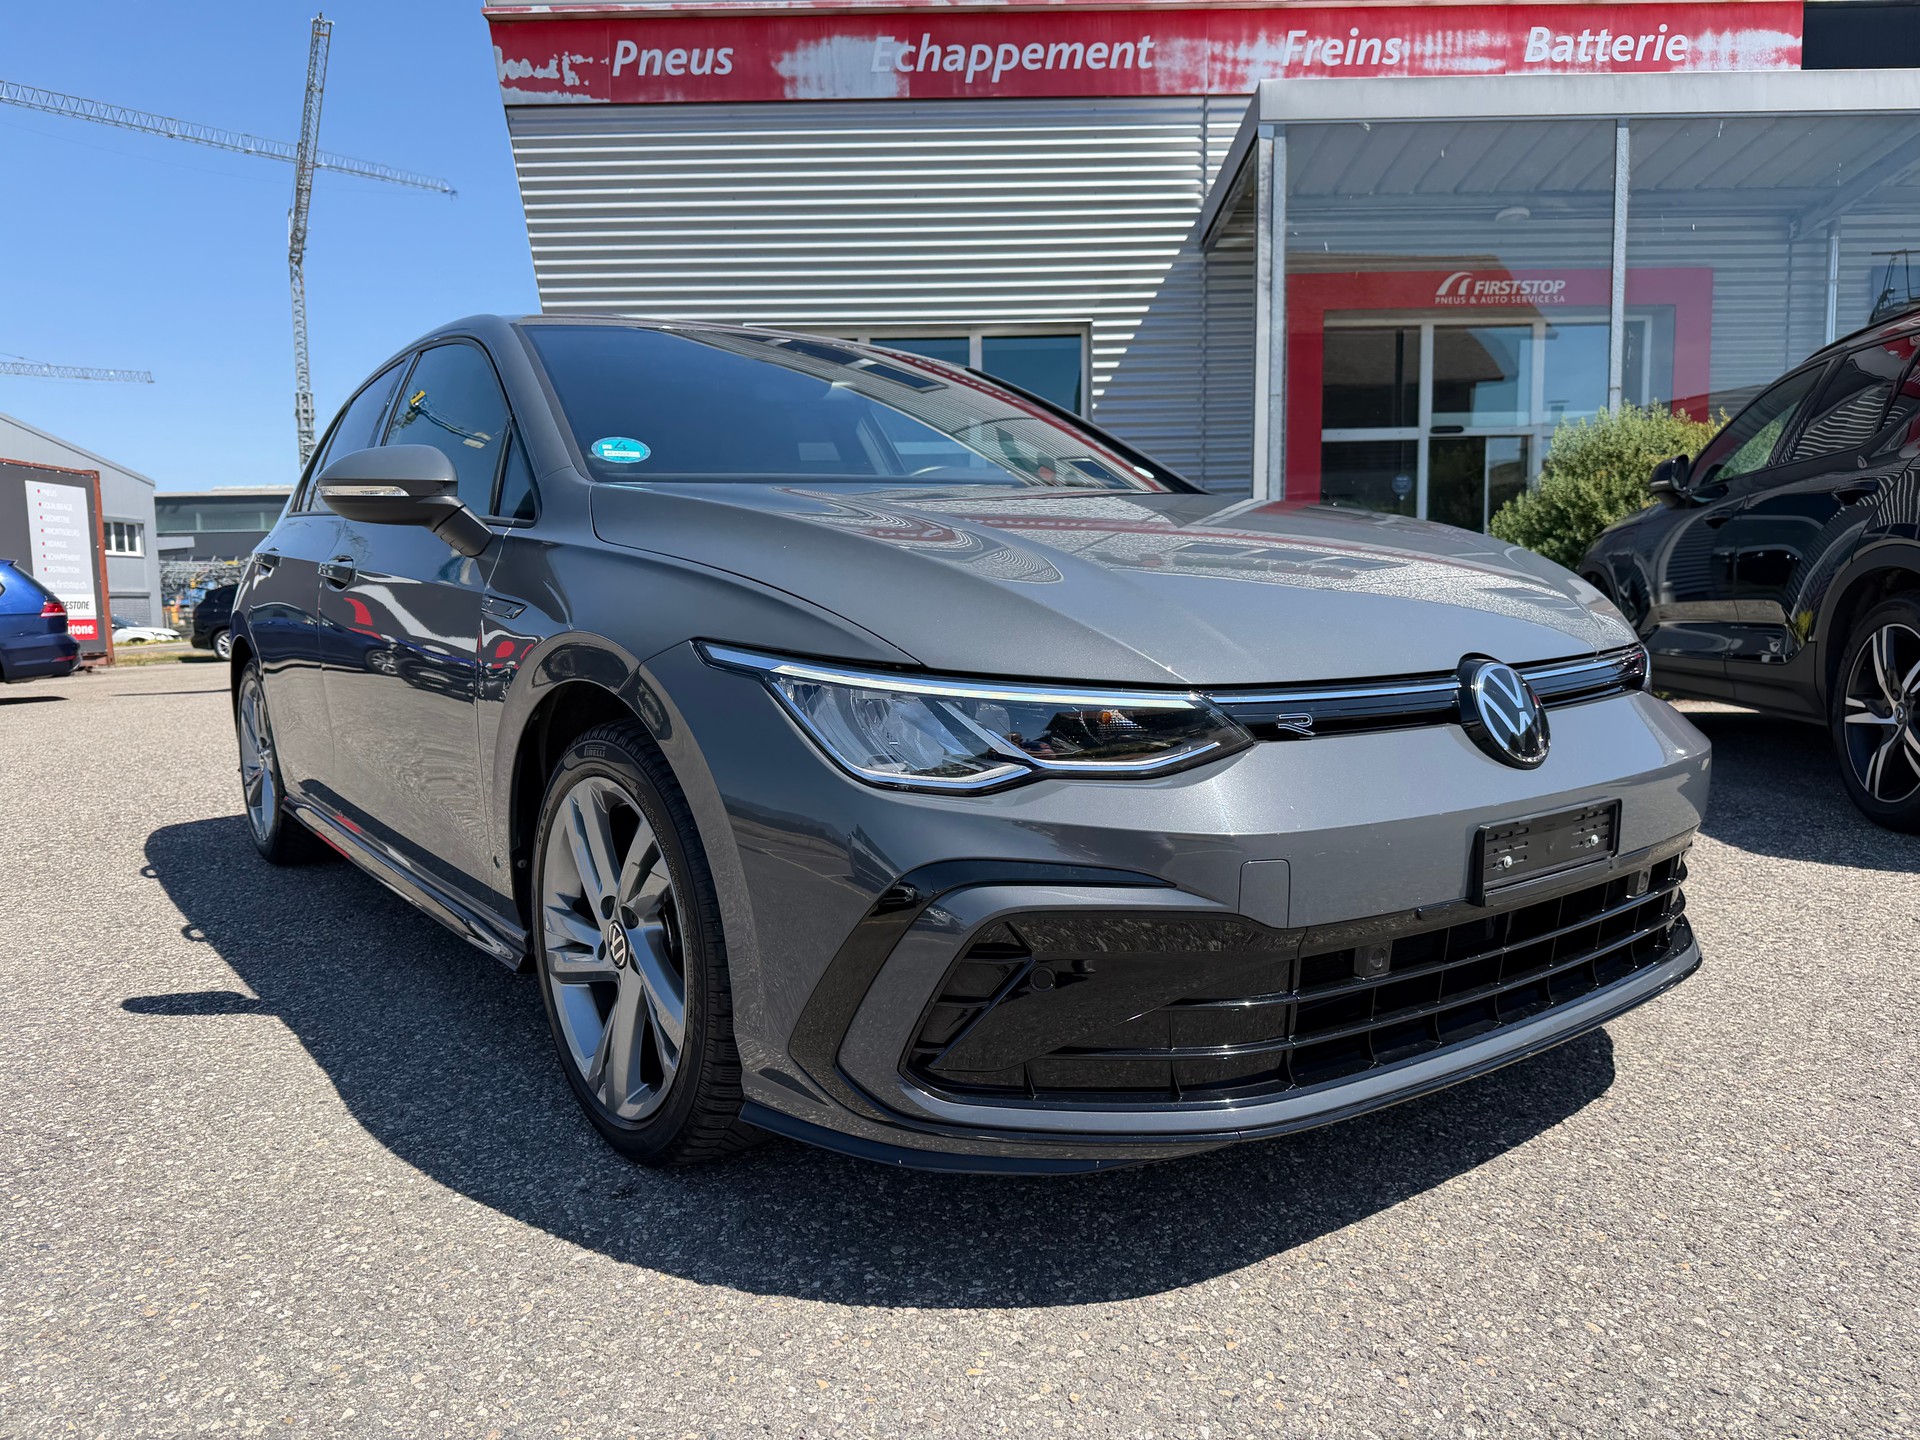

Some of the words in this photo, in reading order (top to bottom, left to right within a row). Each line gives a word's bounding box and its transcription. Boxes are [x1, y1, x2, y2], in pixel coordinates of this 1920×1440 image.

[611, 39, 735, 78] Pneus
[870, 34, 1156, 84] Echappement
[1281, 28, 1403, 67] Freins
[1523, 23, 1689, 63] Batterie
[1434, 296, 1467, 305] PNEUS
[1469, 296, 1477, 304] &
[1479, 296, 1508, 304] AUTO
[1510, 295, 1550, 304] SERVICE
[1552, 295, 1566, 303] SA
[1473, 279, 1567, 295] FIRSTSTOP
[583, 744, 607, 758] PIRELLI
